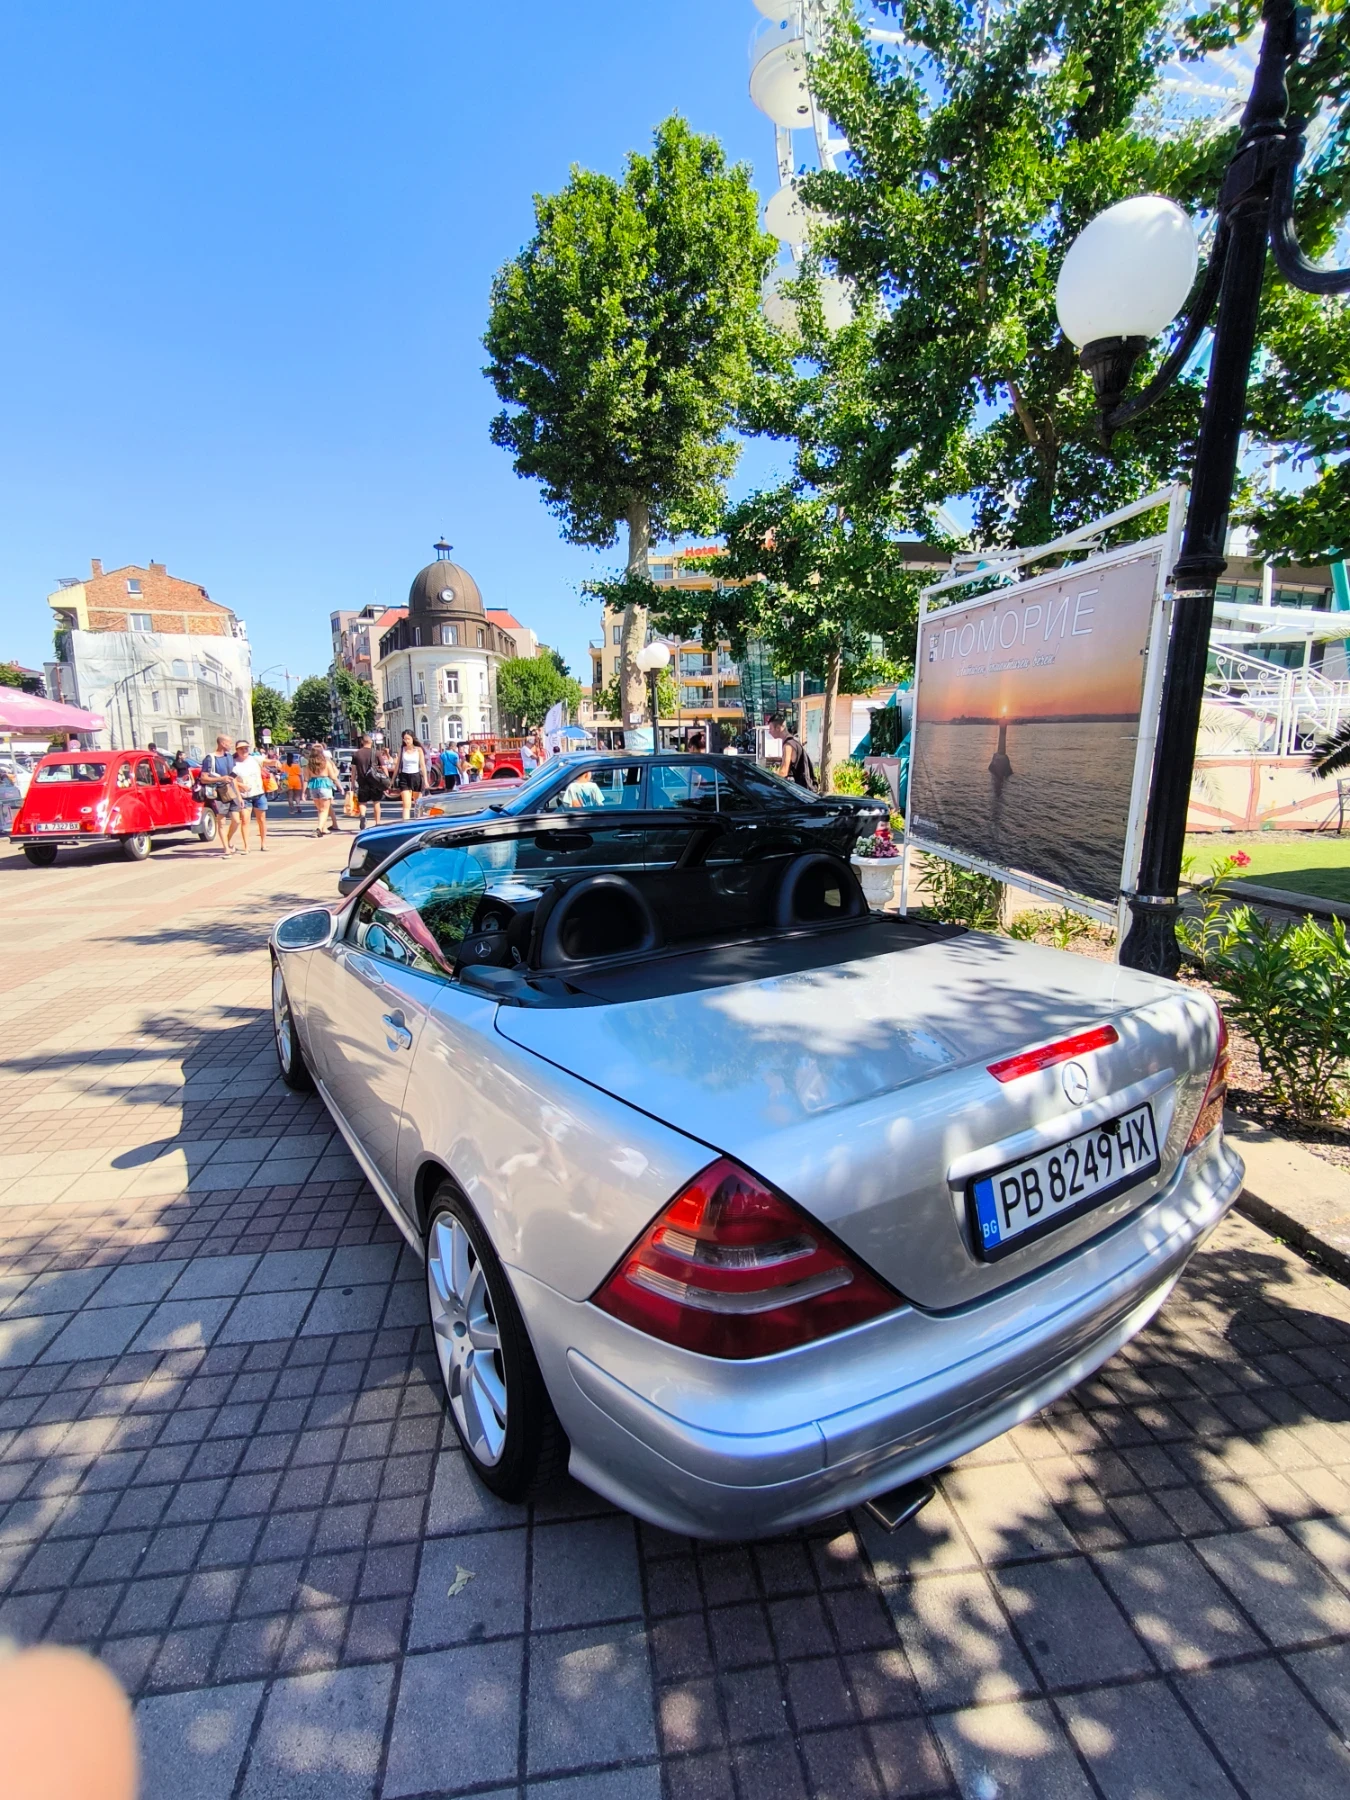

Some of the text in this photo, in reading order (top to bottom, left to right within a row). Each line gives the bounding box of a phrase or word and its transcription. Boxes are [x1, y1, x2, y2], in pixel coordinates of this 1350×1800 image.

[685, 545, 718, 557] Hotel
[941, 589, 1099, 660] ПОМОРИЕ
[1000, 1113, 1151, 1229] PB 8249 HX
[982, 1219, 998, 1239] BG
